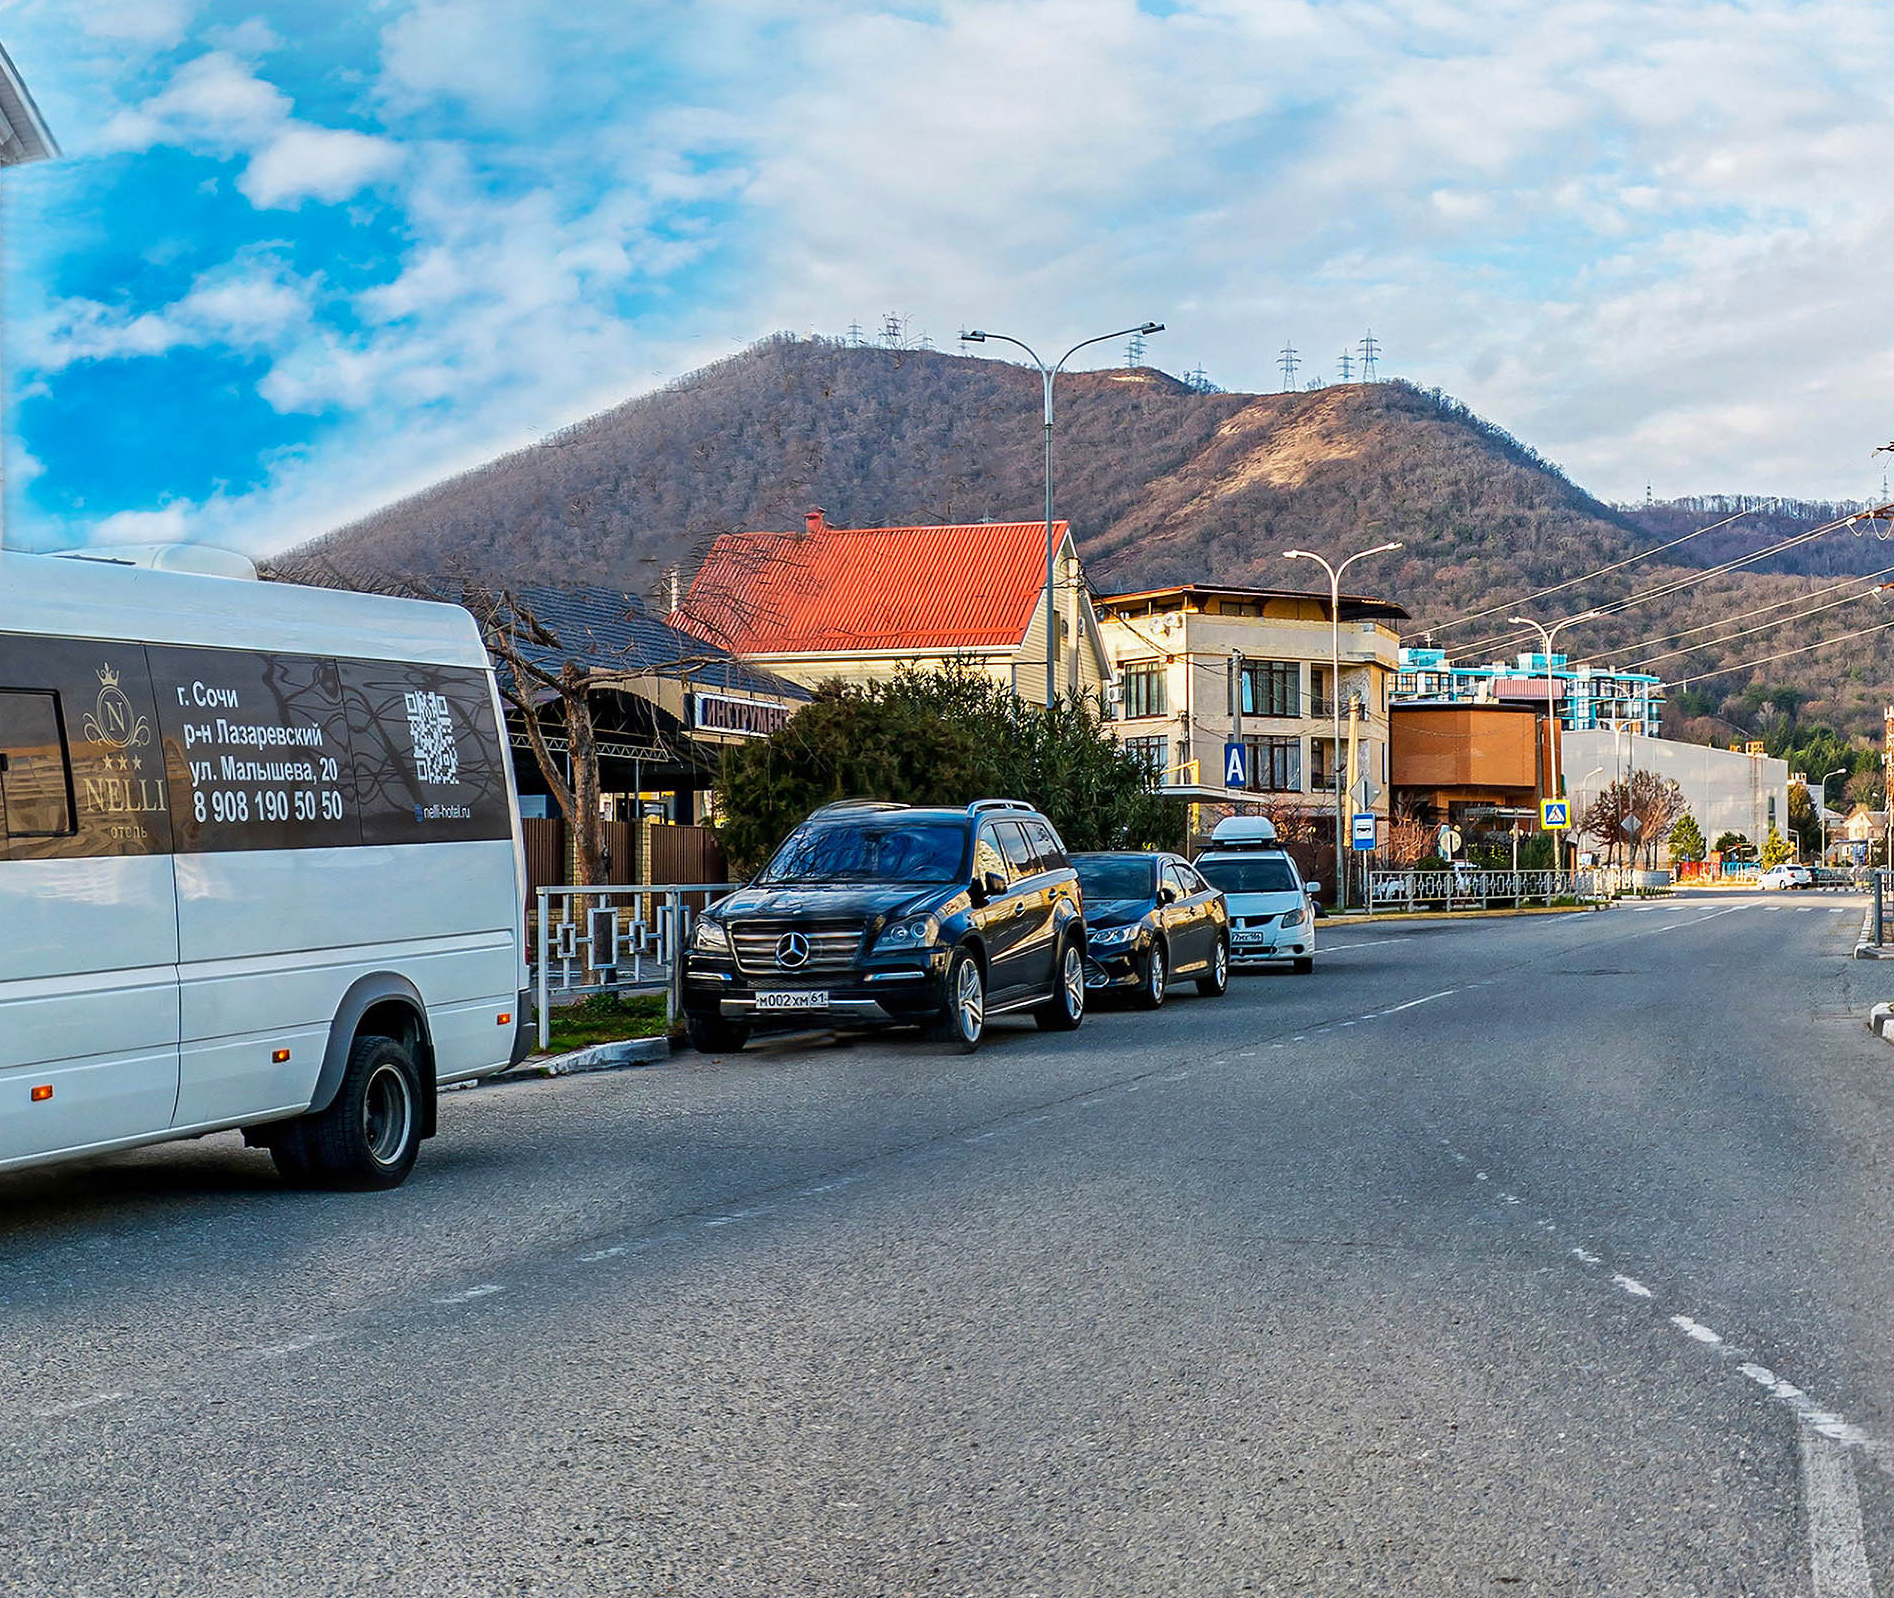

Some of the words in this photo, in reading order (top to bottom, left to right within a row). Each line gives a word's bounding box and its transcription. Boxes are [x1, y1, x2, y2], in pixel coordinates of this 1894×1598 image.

[176, 686, 190, 706] г.
[192, 680, 239, 708] Сочи
[183, 723, 212, 749] р-н
[215, 718, 323, 751] Лазаревский
[189, 760, 217, 787] ул.
[220, 756, 317, 785] Малышева,
[319, 757, 338, 782] 20
[83, 778, 167, 813] NELLI
[193, 790, 207, 823] 8
[212, 790, 249, 822] 908
[254, 790, 288, 821] 190
[294, 790, 316, 821] 50
[321, 790, 343, 820] 50
[111, 826, 148, 839] отель
